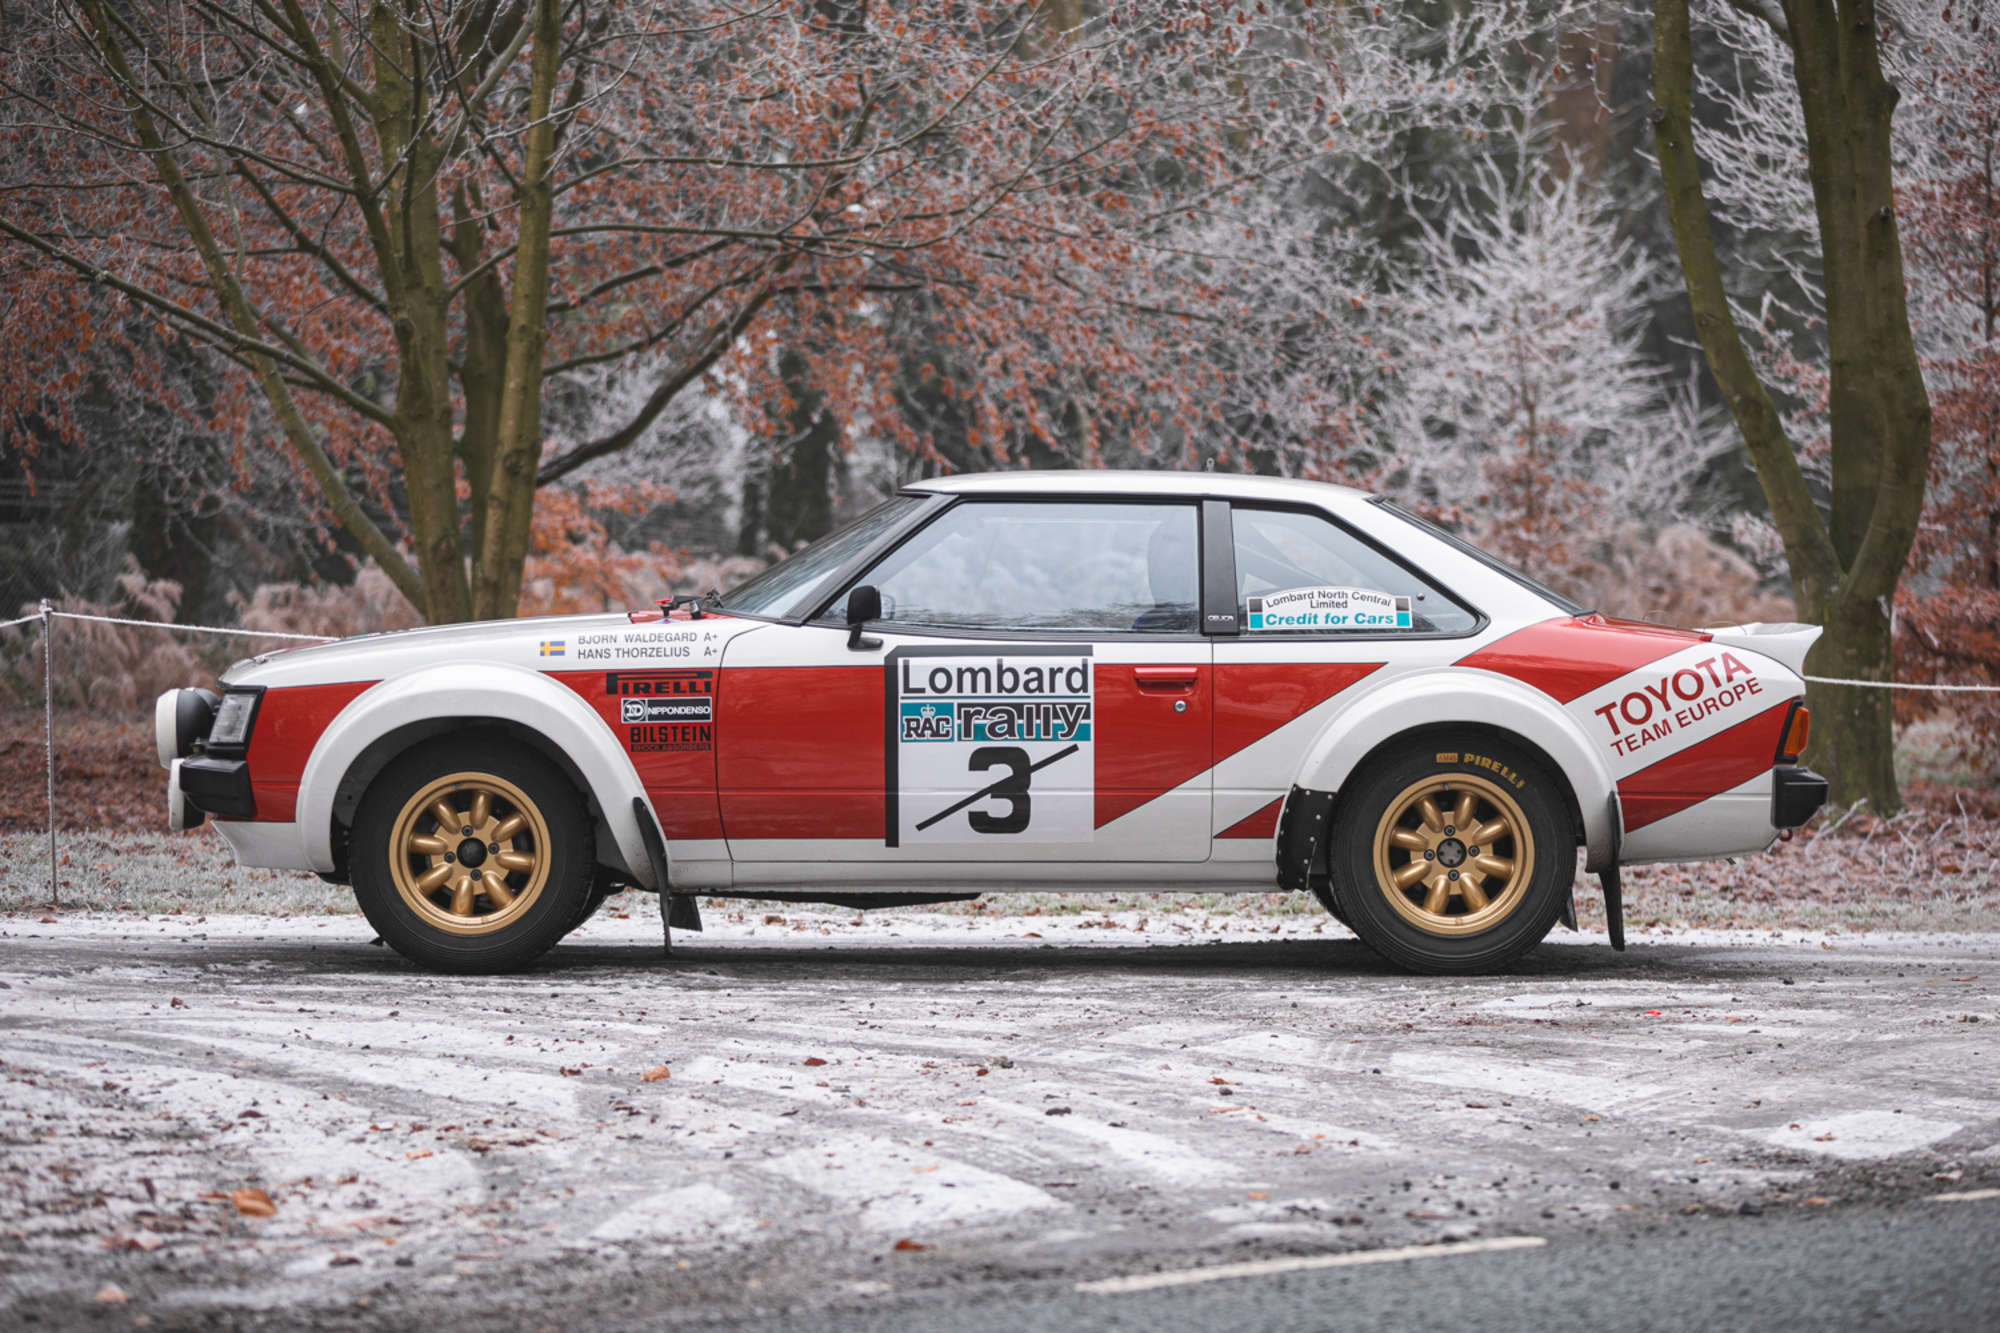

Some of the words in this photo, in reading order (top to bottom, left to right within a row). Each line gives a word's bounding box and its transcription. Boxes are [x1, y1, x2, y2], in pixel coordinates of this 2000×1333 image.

[1266, 591, 1314, 608] Lombard
[1318, 590, 1348, 600] North
[1351, 591, 1391, 607] Central
[1310, 600, 1348, 609] Limited
[1265, 613, 1318, 625] Credit
[1324, 612, 1348, 625] for
[1354, 612, 1394, 625] Cars
[624, 632, 697, 643] WALDEGARD
[704, 632, 717, 642] A+
[578, 648, 611, 660] HANS
[615, 646, 690, 658] THORZELIUS
[704, 646, 717, 657] A+
[606, 671, 712, 695] PIRELLI
[903, 658, 1088, 694] Lombard
[1594, 651, 1752, 737] TOYOTA
[647, 705, 711, 715] NIPPONDENSO
[1610, 719, 1672, 757] TEAM
[1675, 677, 1763, 728] EUROPE
[903, 716, 952, 739] RAC
[961, 704, 1088, 740] rally
[630, 725, 711, 743] BILSTEIN
[1463, 752, 1526, 790] PIRELLI
[968, 746, 1031, 834] 3
